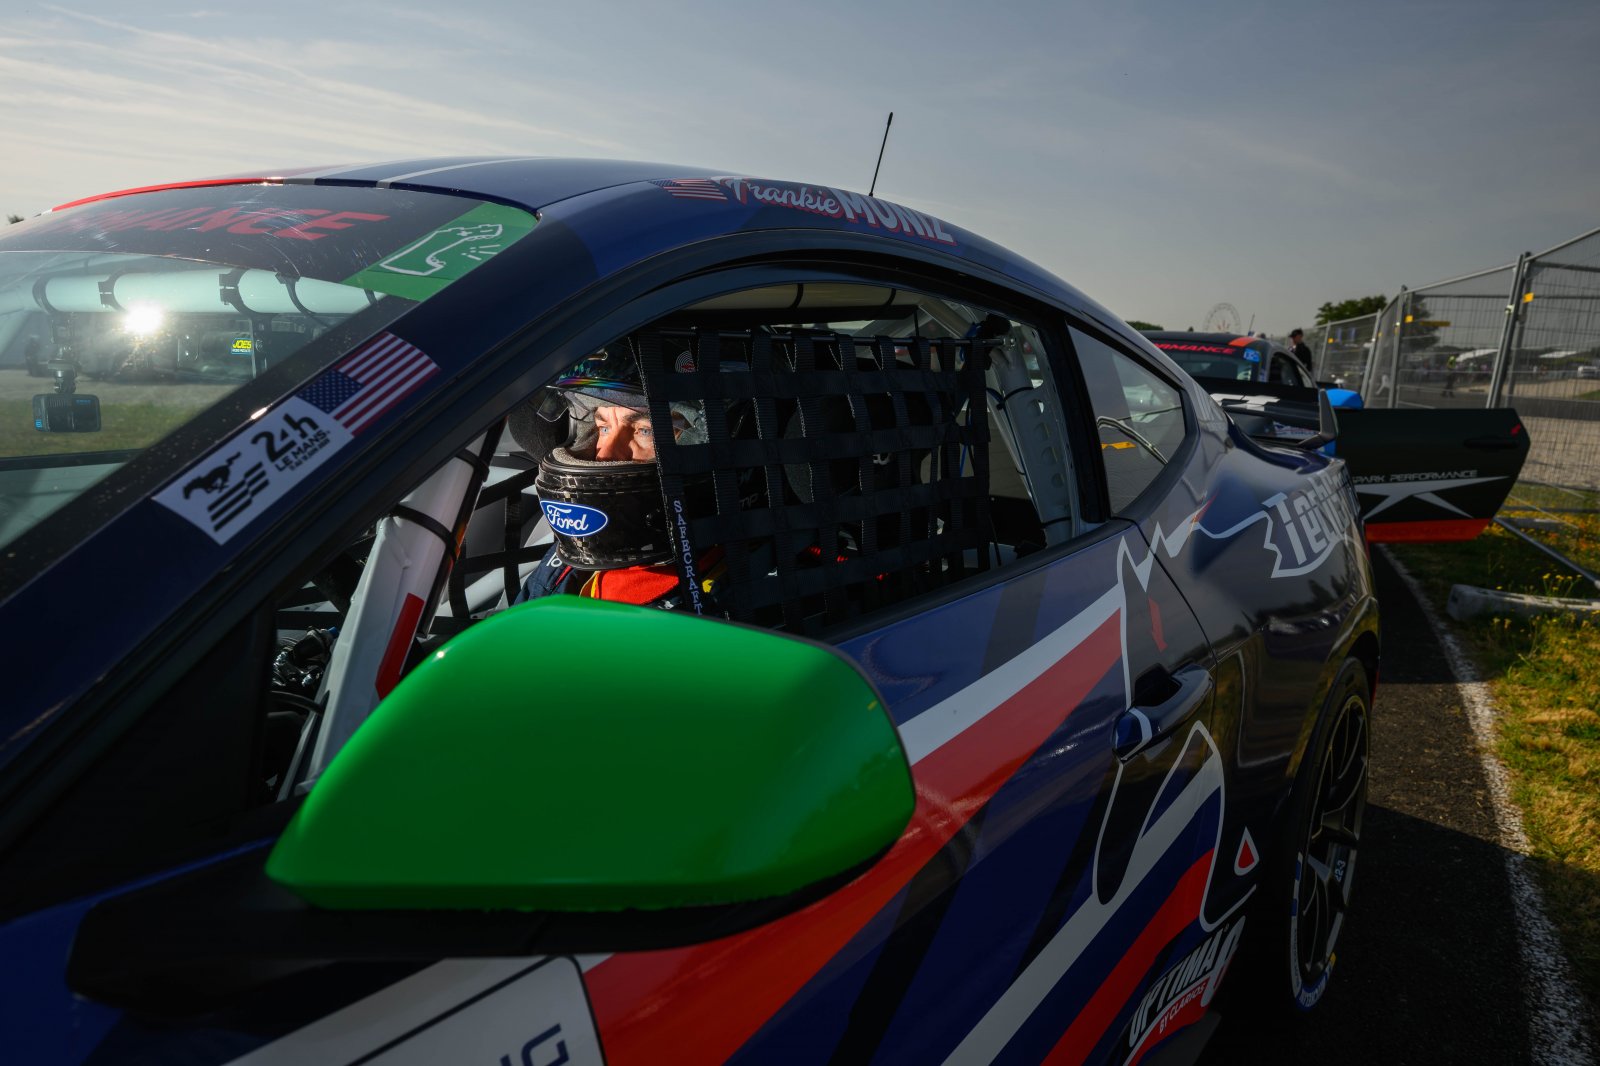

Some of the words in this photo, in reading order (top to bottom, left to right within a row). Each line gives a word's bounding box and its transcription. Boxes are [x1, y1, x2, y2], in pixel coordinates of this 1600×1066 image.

[709, 176, 840, 216] Frankie
[829, 188, 954, 244] MUNIZ
[250, 413, 319, 463] 24h
[275, 456, 293, 472] LE
[291, 429, 328, 459] MANS
[1390, 469, 1478, 482] PERFORMANCE
[546, 504, 589, 531] Ford
[673, 500, 703, 616] SAFECRAFT
